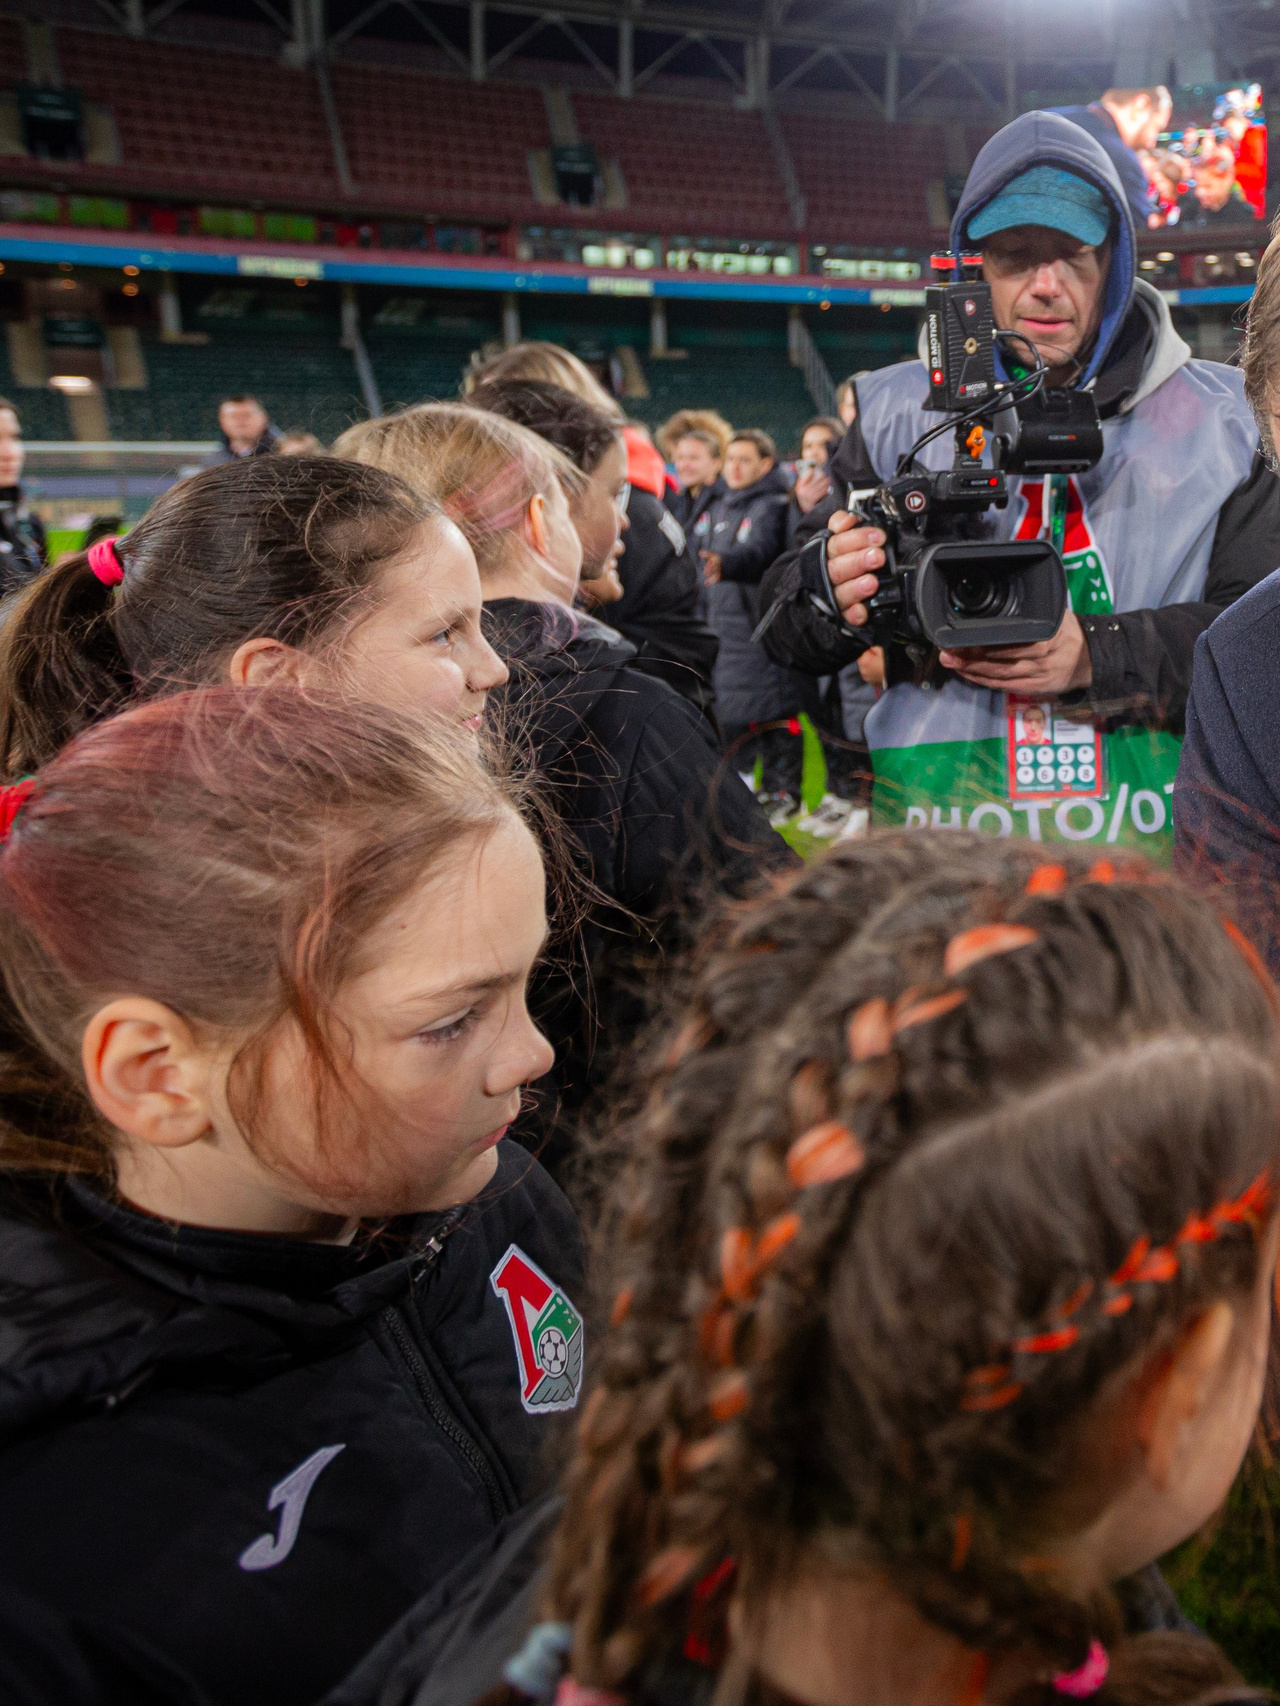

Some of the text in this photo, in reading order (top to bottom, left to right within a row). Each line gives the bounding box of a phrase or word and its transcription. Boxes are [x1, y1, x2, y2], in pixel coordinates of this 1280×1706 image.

[929, 314, 938, 356] MOTION
[1062, 750, 1069, 760] 3
[1041, 770, 1048, 780] 6
[1062, 769, 1069, 779] 7
[1083, 769, 1090, 779] 8
[904, 782, 1174, 843] PHOTO/0
